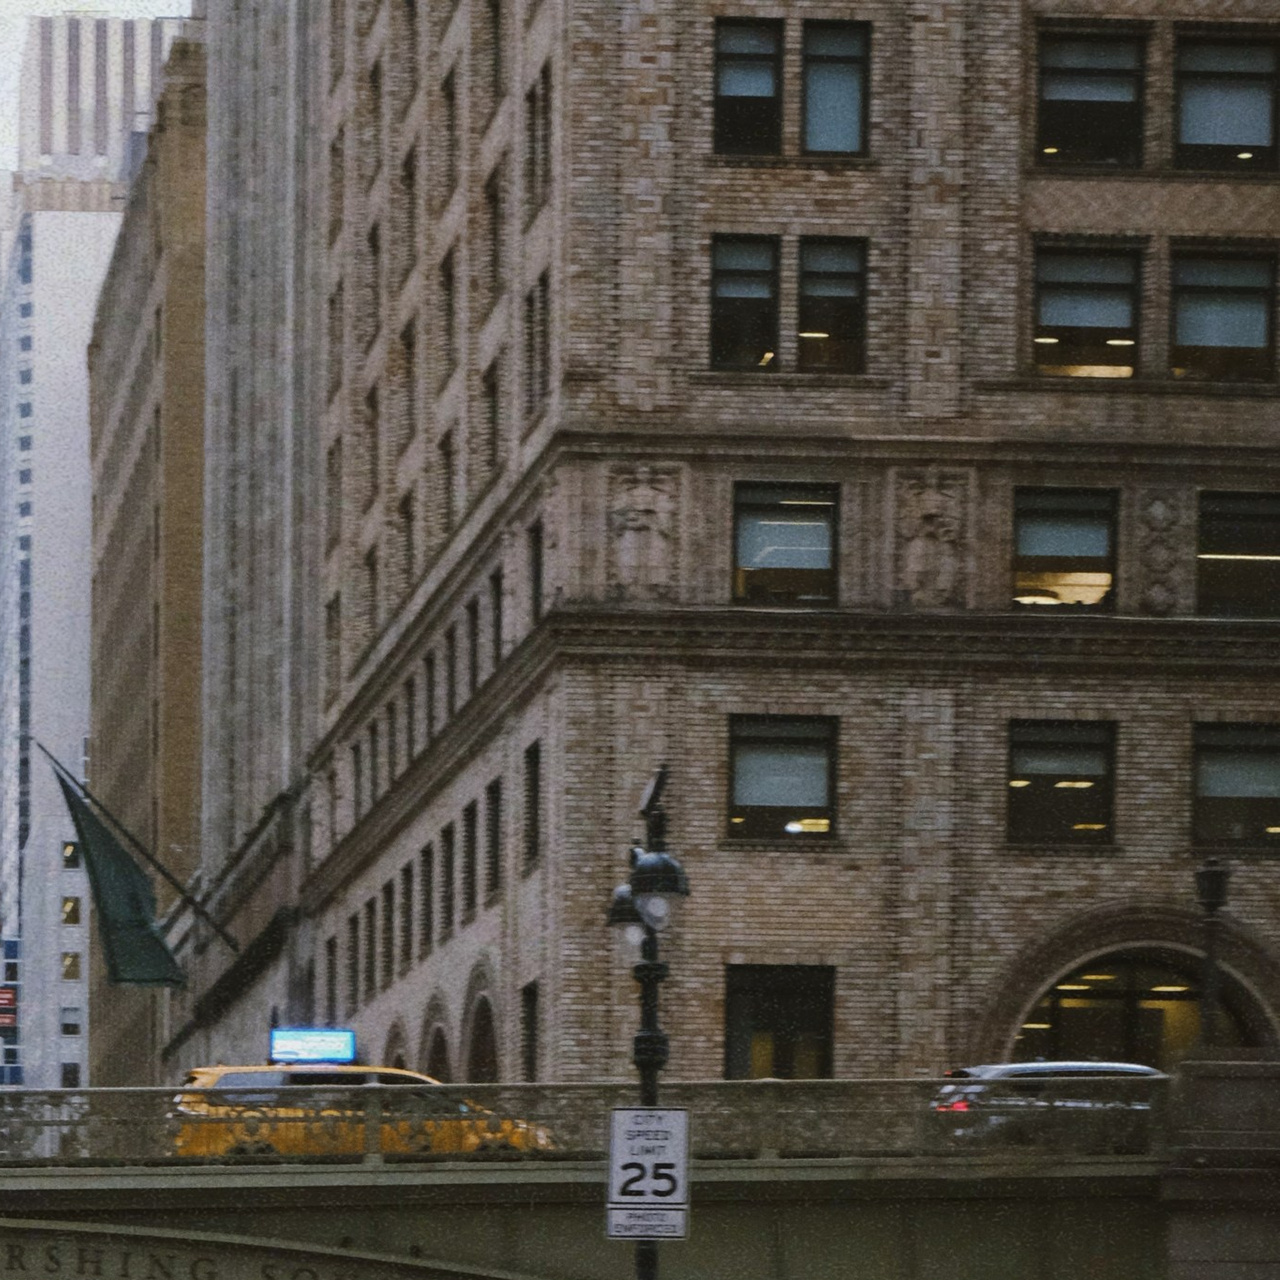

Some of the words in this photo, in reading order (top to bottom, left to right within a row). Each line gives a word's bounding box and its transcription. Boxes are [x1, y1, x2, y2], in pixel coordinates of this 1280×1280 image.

[625, 1130, 672, 1140] SPEED
[629, 1145, 666, 1155] LIMIT
[619, 1162, 678, 1197] 25
